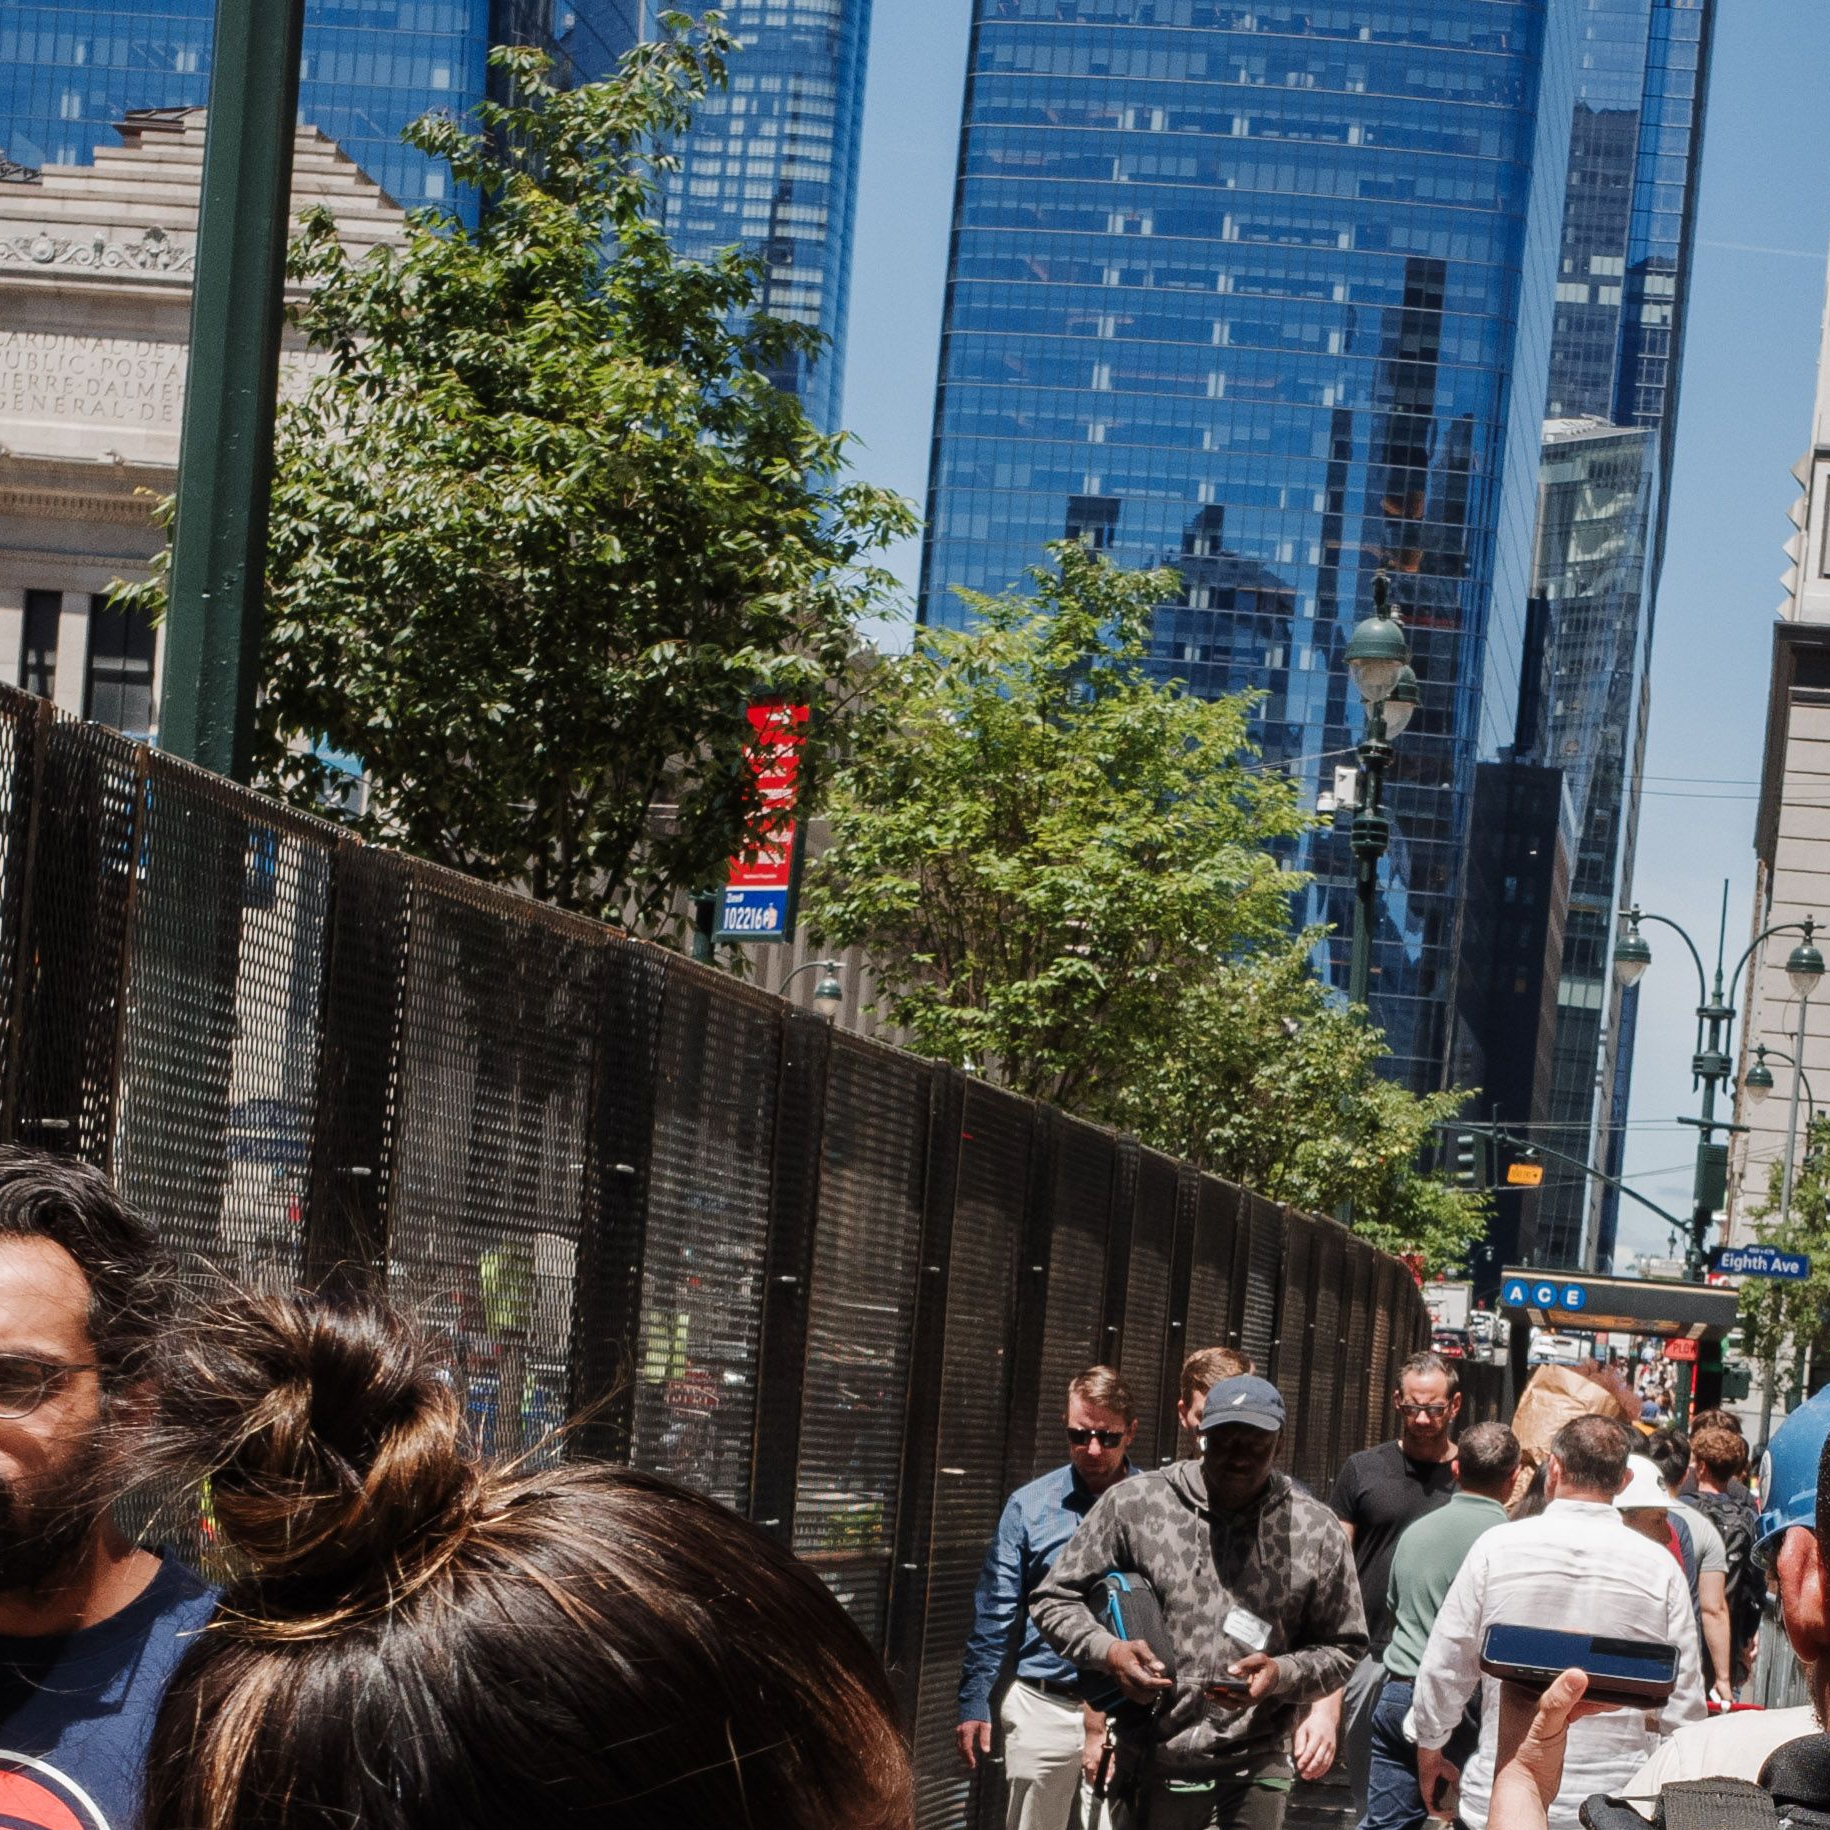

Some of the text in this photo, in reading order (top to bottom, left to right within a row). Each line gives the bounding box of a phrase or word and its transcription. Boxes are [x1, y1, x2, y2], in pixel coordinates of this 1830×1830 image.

[100, 357, 181, 380] POSTA
[724, 907, 763, 930] 102216
[1721, 1252, 1768, 1273] Eighth
[1771, 1256, 1800, 1274] Ave
[1510, 1286, 1579, 1305] A C E
